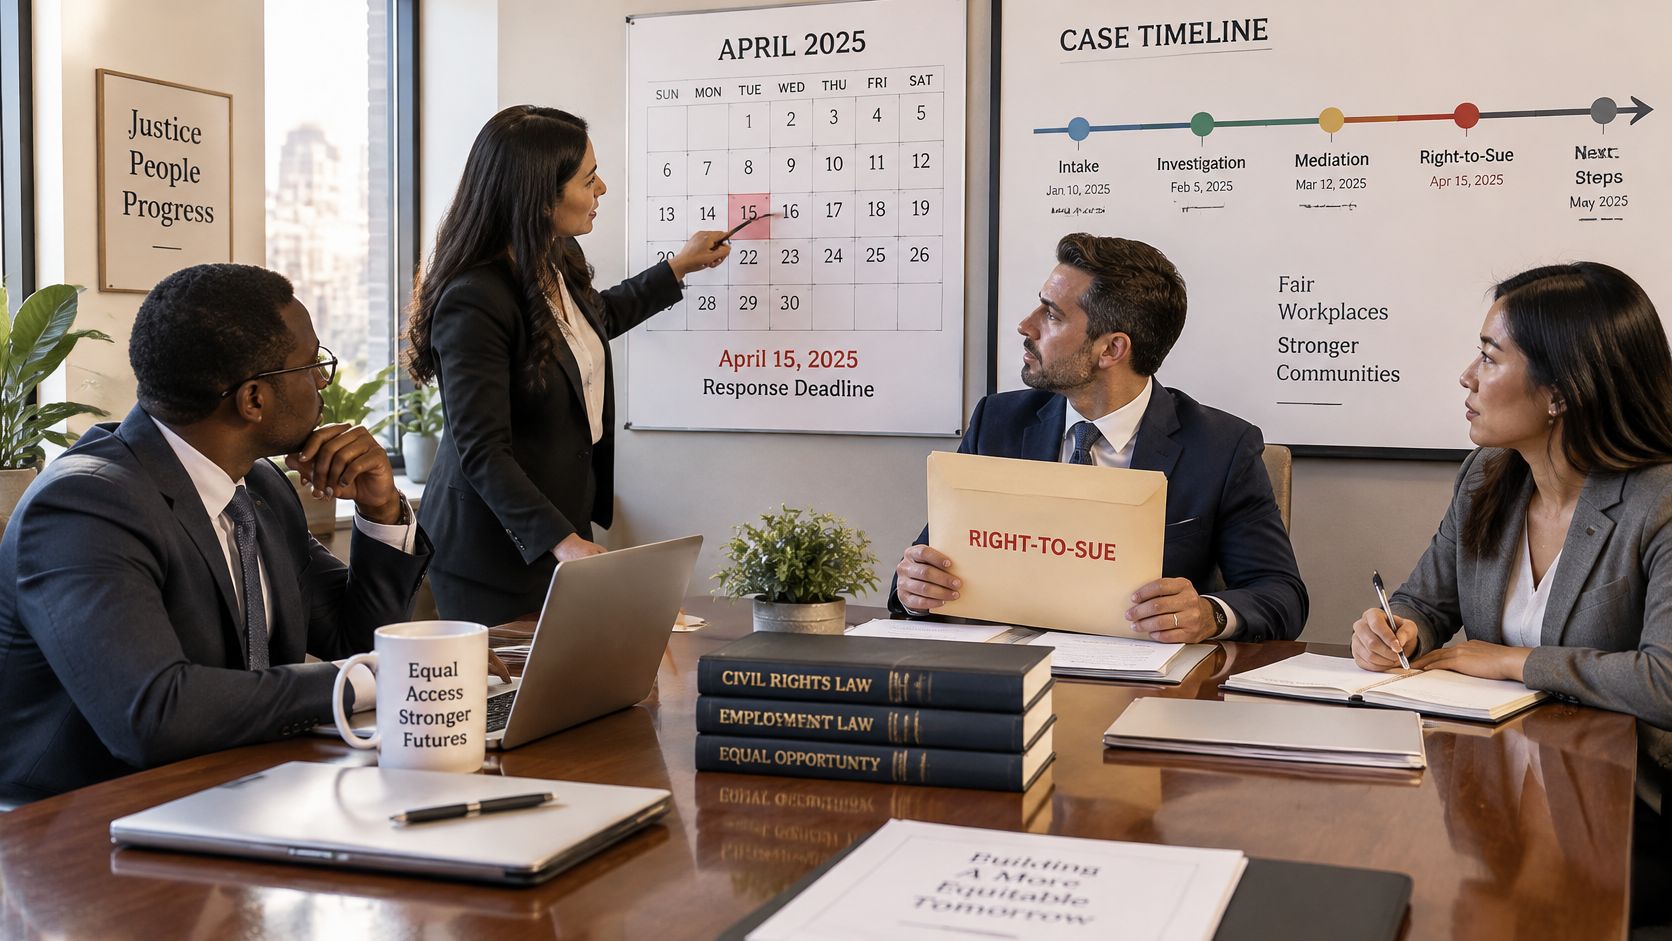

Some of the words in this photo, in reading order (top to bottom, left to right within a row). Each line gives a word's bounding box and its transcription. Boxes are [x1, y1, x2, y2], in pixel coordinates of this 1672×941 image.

[1060, 27, 1130, 51] CASE
[1138, 18, 1268, 47] TIMELINE
[717, 36, 796, 60] APRIL
[804, 30, 866, 55] 2025
[655, 88, 679, 101] SUN
[695, 86, 722, 99] MON
[738, 84, 762, 96] TUE
[777, 81, 806, 94] WED
[821, 79, 847, 91] THU
[867, 76, 888, 89] FRI
[909, 73, 934, 87] SAT
[127, 109, 202, 144] Justice
[745, 113, 752, 129] 1
[786, 111, 796, 127] 2
[829, 108, 839, 125] 3
[872, 107, 882, 123] 4
[916, 104, 926, 121] 5
[663, 162, 672, 178] 6
[703, 160, 712, 176] 7
[744, 159, 753, 175] 8
[786, 157, 796, 173] 9
[825, 155, 844, 172] 10
[869, 154, 885, 171] 11
[912, 152, 931, 169] 12
[1059, 159, 1100, 174] Intake
[1157, 155, 1246, 174] Investigation
[1295, 151, 1369, 168] Mediation
[1420, 147, 1514, 168] Right-to-Sue
[129, 150, 201, 187] People
[1171, 181, 1191, 193] Feb
[1193, 181, 1203, 194] 5,
[1205, 180, 1233, 192] 2025
[1295, 179, 1318, 191] Mar
[1320, 178, 1336, 192] 12,
[1338, 177, 1367, 190] 2025
[1429, 175, 1452, 190] Apr
[1455, 174, 1472, 188] 15,
[1474, 173, 1504, 186] 2025
[1575, 170, 1624, 188] Steps
[1067, 184, 1082, 197] 10,
[1084, 183, 1111, 195] 2025
[122, 191, 214, 227] Progress
[659, 206, 675, 222] 13
[699, 206, 716, 221] 14
[741, 205, 757, 220] 15
[782, 203, 800, 219] 16
[825, 201, 843, 218] 17
[868, 200, 886, 217] 18
[912, 199, 930, 217] 19
[1569, 195, 1596, 213] May
[1599, 194, 1629, 208] 2025
[739, 249, 758, 265] 22
[781, 248, 800, 265] 23
[824, 248, 844, 264] 24
[866, 247, 886, 263] 25
[909, 246, 930, 263] 26
[1278, 275, 1315, 293] Fair
[698, 295, 717, 311] 28
[739, 295, 758, 311] 29
[780, 295, 800, 311] 30
[1277, 302, 1389, 324] Workplaces
[1278, 337, 1360, 358] Stronger
[718, 350, 766, 372] April
[773, 350, 801, 371] 15,
[807, 349, 859, 369] 2025
[1276, 363, 1400, 383] Communities
[703, 378, 789, 400] Response
[794, 379, 875, 398] Deadline
[969, 530, 1116, 561] RIGHT-TO-SUE
[408, 661, 458, 683] Equal
[722, 670, 766, 687] CIVIL
[770, 672, 831, 691] RIGHTS
[835, 676, 873, 692] LAW
[405, 685, 464, 703] Access
[399, 708, 472, 728] Stronger
[837, 715, 874, 732] LAW
[403, 731, 467, 748] Futures
[719, 746, 771, 765] EQUAL
[956, 868, 979, 879] A
[994, 872, 1080, 887] More
[937, 880, 1089, 906] Equitable
[914, 895, 1094, 925] Tomorrow
